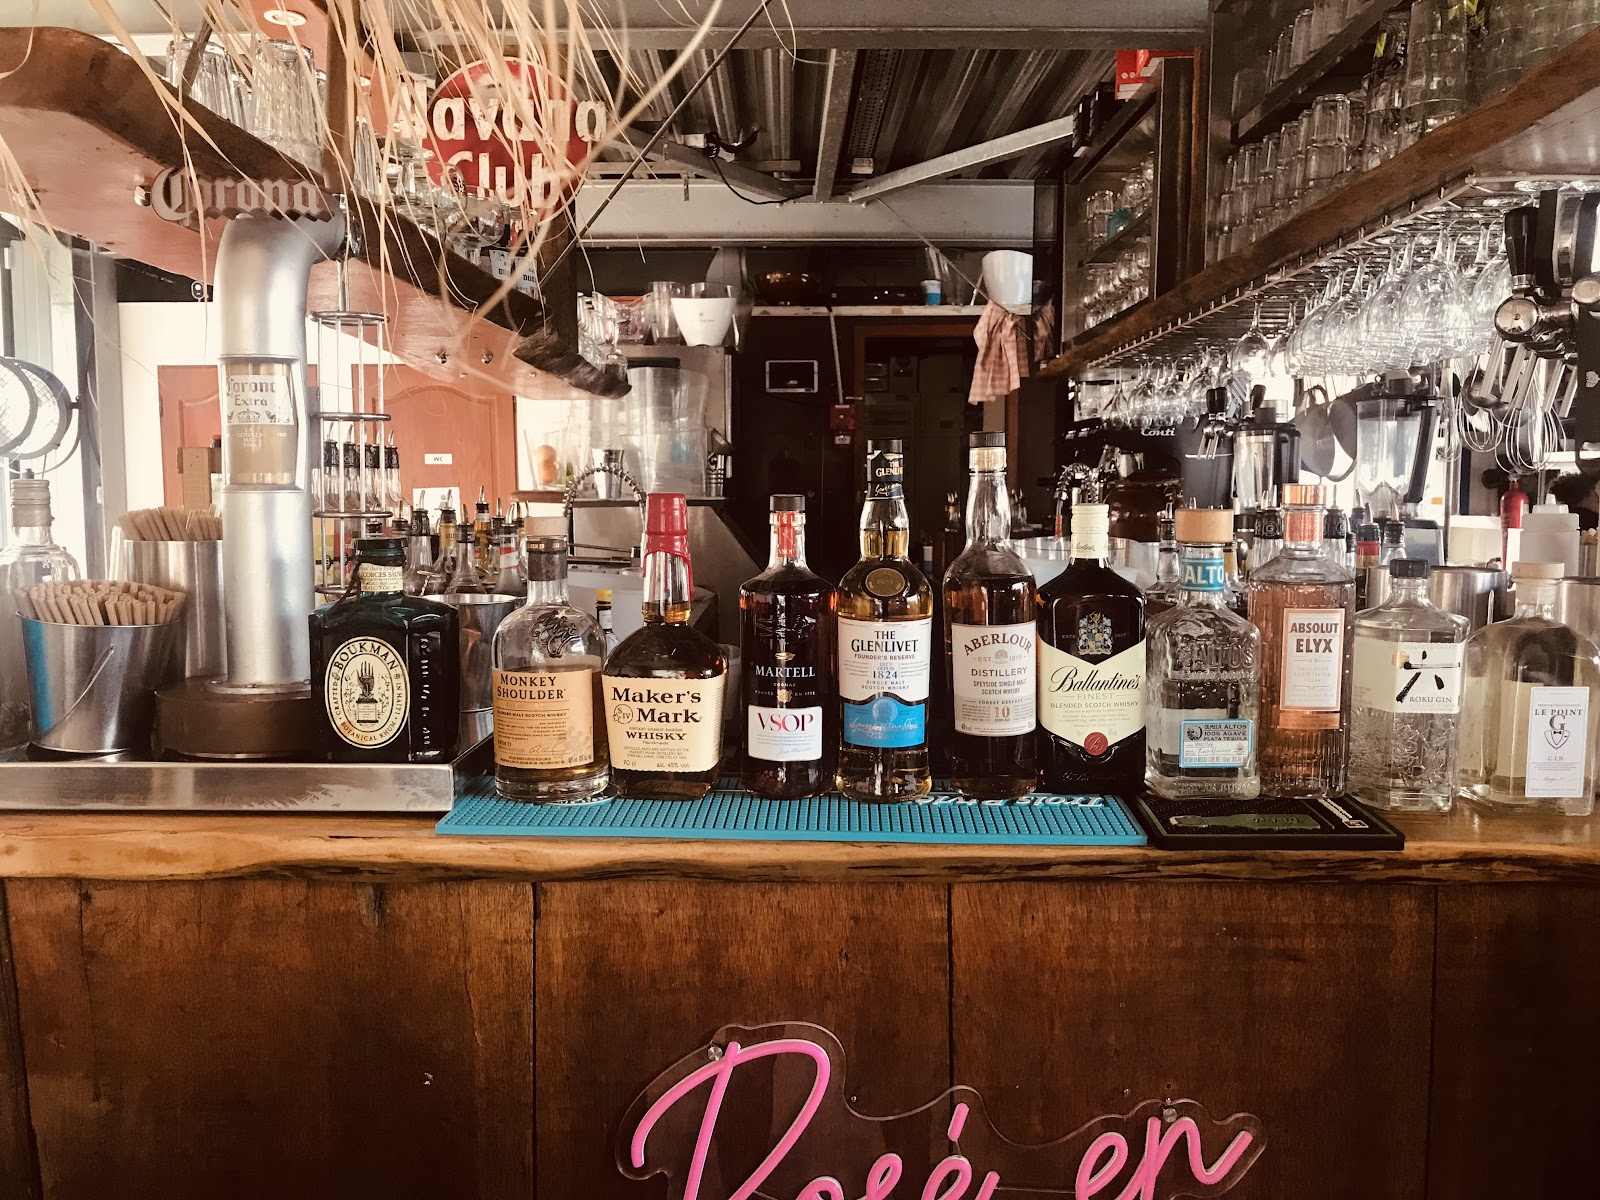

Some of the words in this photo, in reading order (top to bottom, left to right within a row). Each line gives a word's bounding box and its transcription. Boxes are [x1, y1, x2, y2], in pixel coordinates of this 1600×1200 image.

[399, 80, 607, 142] Havana
[441, 151, 561, 208] Club
[151, 167, 323, 226] Corona
[234, 394, 268, 406] Extra
[1140, 427, 1176, 436] Conti
[874, 630, 896, 640] THE
[1290, 622, 1339, 634] ABSOLUT
[851, 638, 918, 653] GLENLIVET
[963, 632, 1032, 656] ABERLOUR
[1295, 638, 1333, 653] ELYX
[333, 642, 399, 671] BOUKMAN
[755, 664, 816, 678] MARTELL
[872, 670, 898, 679] 1824
[971, 667, 1027, 677] DISTILLERY
[1048, 665, 1141, 692] Ballantine's
[500, 673, 556, 687] MONKEY
[332, 681, 341, 716] CRAFTED
[396, 682, 402, 691] IN
[497, 685, 564, 700] SHOULDER
[611, 686, 702, 704] Maker's
[636, 707, 701, 723] Mark
[994, 706, 1010, 718] 10
[757, 712, 814, 732] VSOP
[1549, 713, 1566, 731] G
[340, 721, 378, 741] BOTANICAL
[378, 720, 397, 740] RHUM
[625, 731, 687, 740] WHISKY
[1017, 796, 1104, 807] Trois
